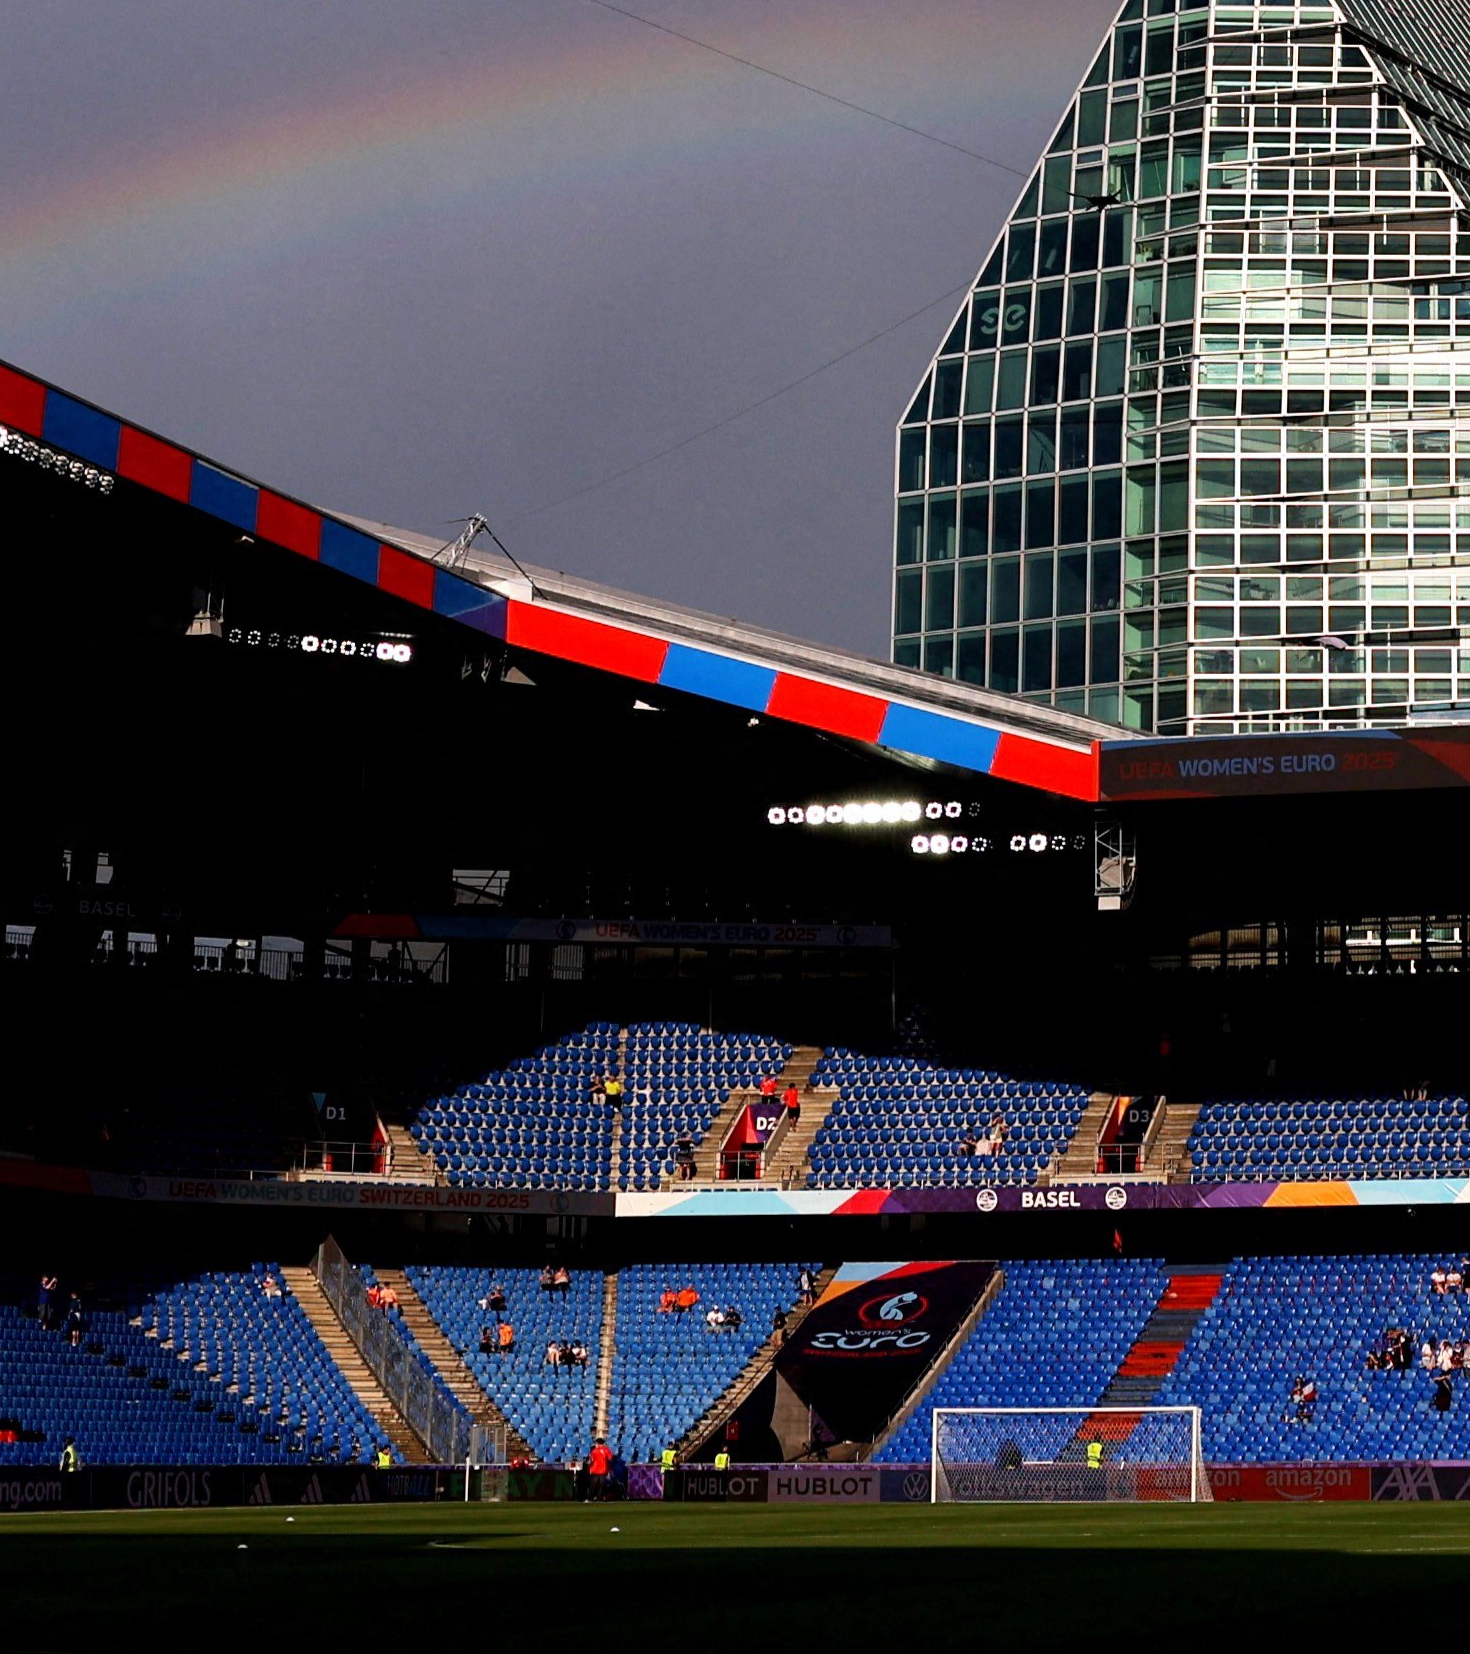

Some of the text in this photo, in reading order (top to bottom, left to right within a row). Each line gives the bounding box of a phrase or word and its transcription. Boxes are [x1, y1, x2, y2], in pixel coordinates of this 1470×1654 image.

[1119, 751, 1394, 780] UEFA WOMEN'S EURO 2025
[79, 899, 136, 918] BASEL
[595, 923, 818, 942] UEFA WOMEN'S EURO 2025
[325, 1106, 347, 1121] D1
[1129, 1109, 1151, 1124] D3
[756, 1116, 779, 1131] D2
[169, 1182, 530, 1210] UEFA WOMEN'S EURO SWITZERLAND 2025
[1021, 1190, 1081, 1209] BASEL
[687, 1477, 759, 1497] HUBLOT
[776, 1477, 873, 1497] HUBLOT
[1265, 1468, 1352, 1487] amazon
[1373, 1465, 1442, 1501] AXA
[127, 1470, 212, 1508] GRIFOLS
